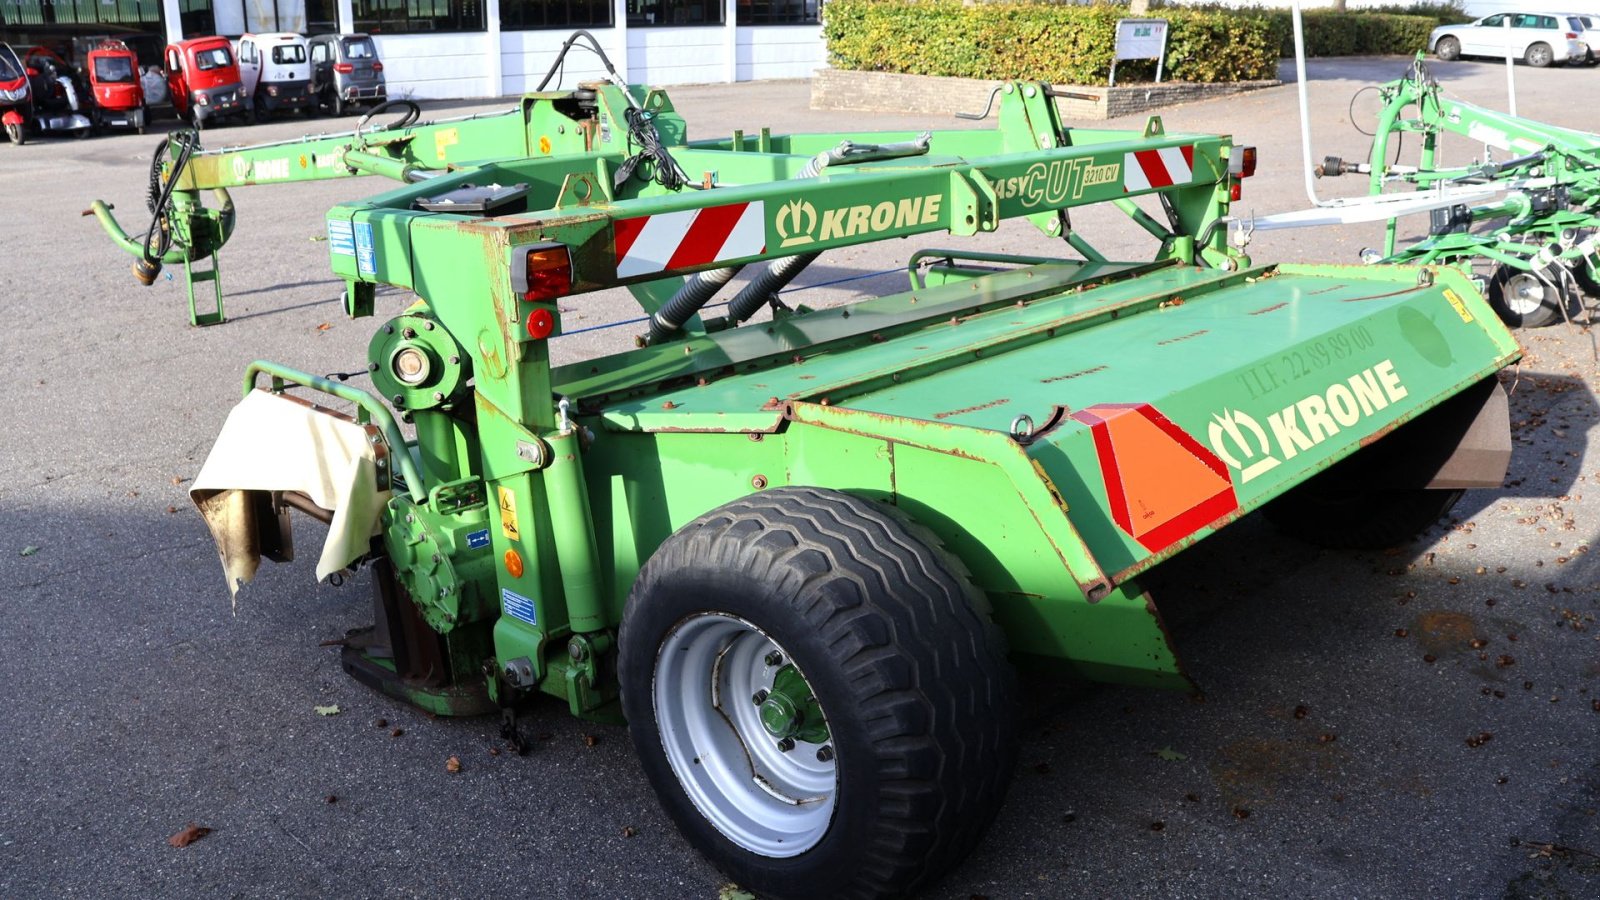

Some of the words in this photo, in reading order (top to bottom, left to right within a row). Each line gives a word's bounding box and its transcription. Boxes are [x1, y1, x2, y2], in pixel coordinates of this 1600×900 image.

[1084, 167, 1104, 184] 3210
[1105, 164, 1118, 181] CV
[819, 194, 943, 241] KRONE
[1282, 350, 1311, 380] 22
[1307, 341, 1332, 369] 89
[1328, 332, 1352, 360] 89
[1351, 325, 1375, 351] 00
[1266, 359, 1409, 461] KRONE
